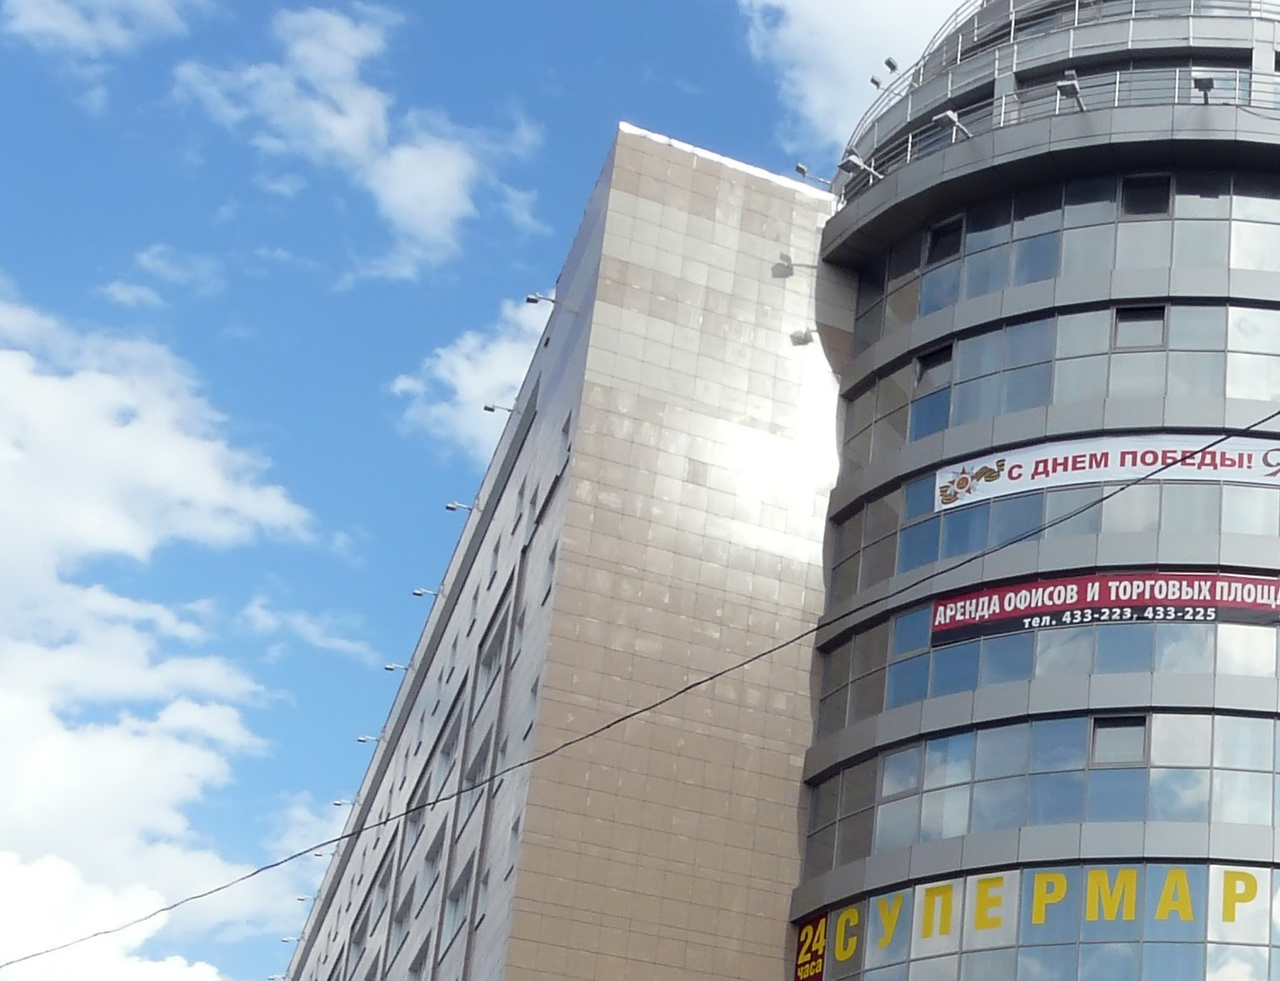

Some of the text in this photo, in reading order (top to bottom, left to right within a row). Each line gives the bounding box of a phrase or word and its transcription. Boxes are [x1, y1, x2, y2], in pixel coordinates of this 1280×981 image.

[1007, 465, 1023, 481] С
[1030, 451, 1110, 480] ДНЕМ
[1118, 448, 1253, 471] ПОБЕДЫ!
[934, 593, 1000, 626] АРЕНДА
[1003, 584, 1078, 612] ОФИСОВ
[1086, 580, 1101, 602] И
[1108, 579, 1212, 603] ТОРГОВЫХ
[1023, 606, 1216, 629] тел. 433-223, 433-225
[797, 917, 827, 965] 24
[797, 958, 823, 980] часа
